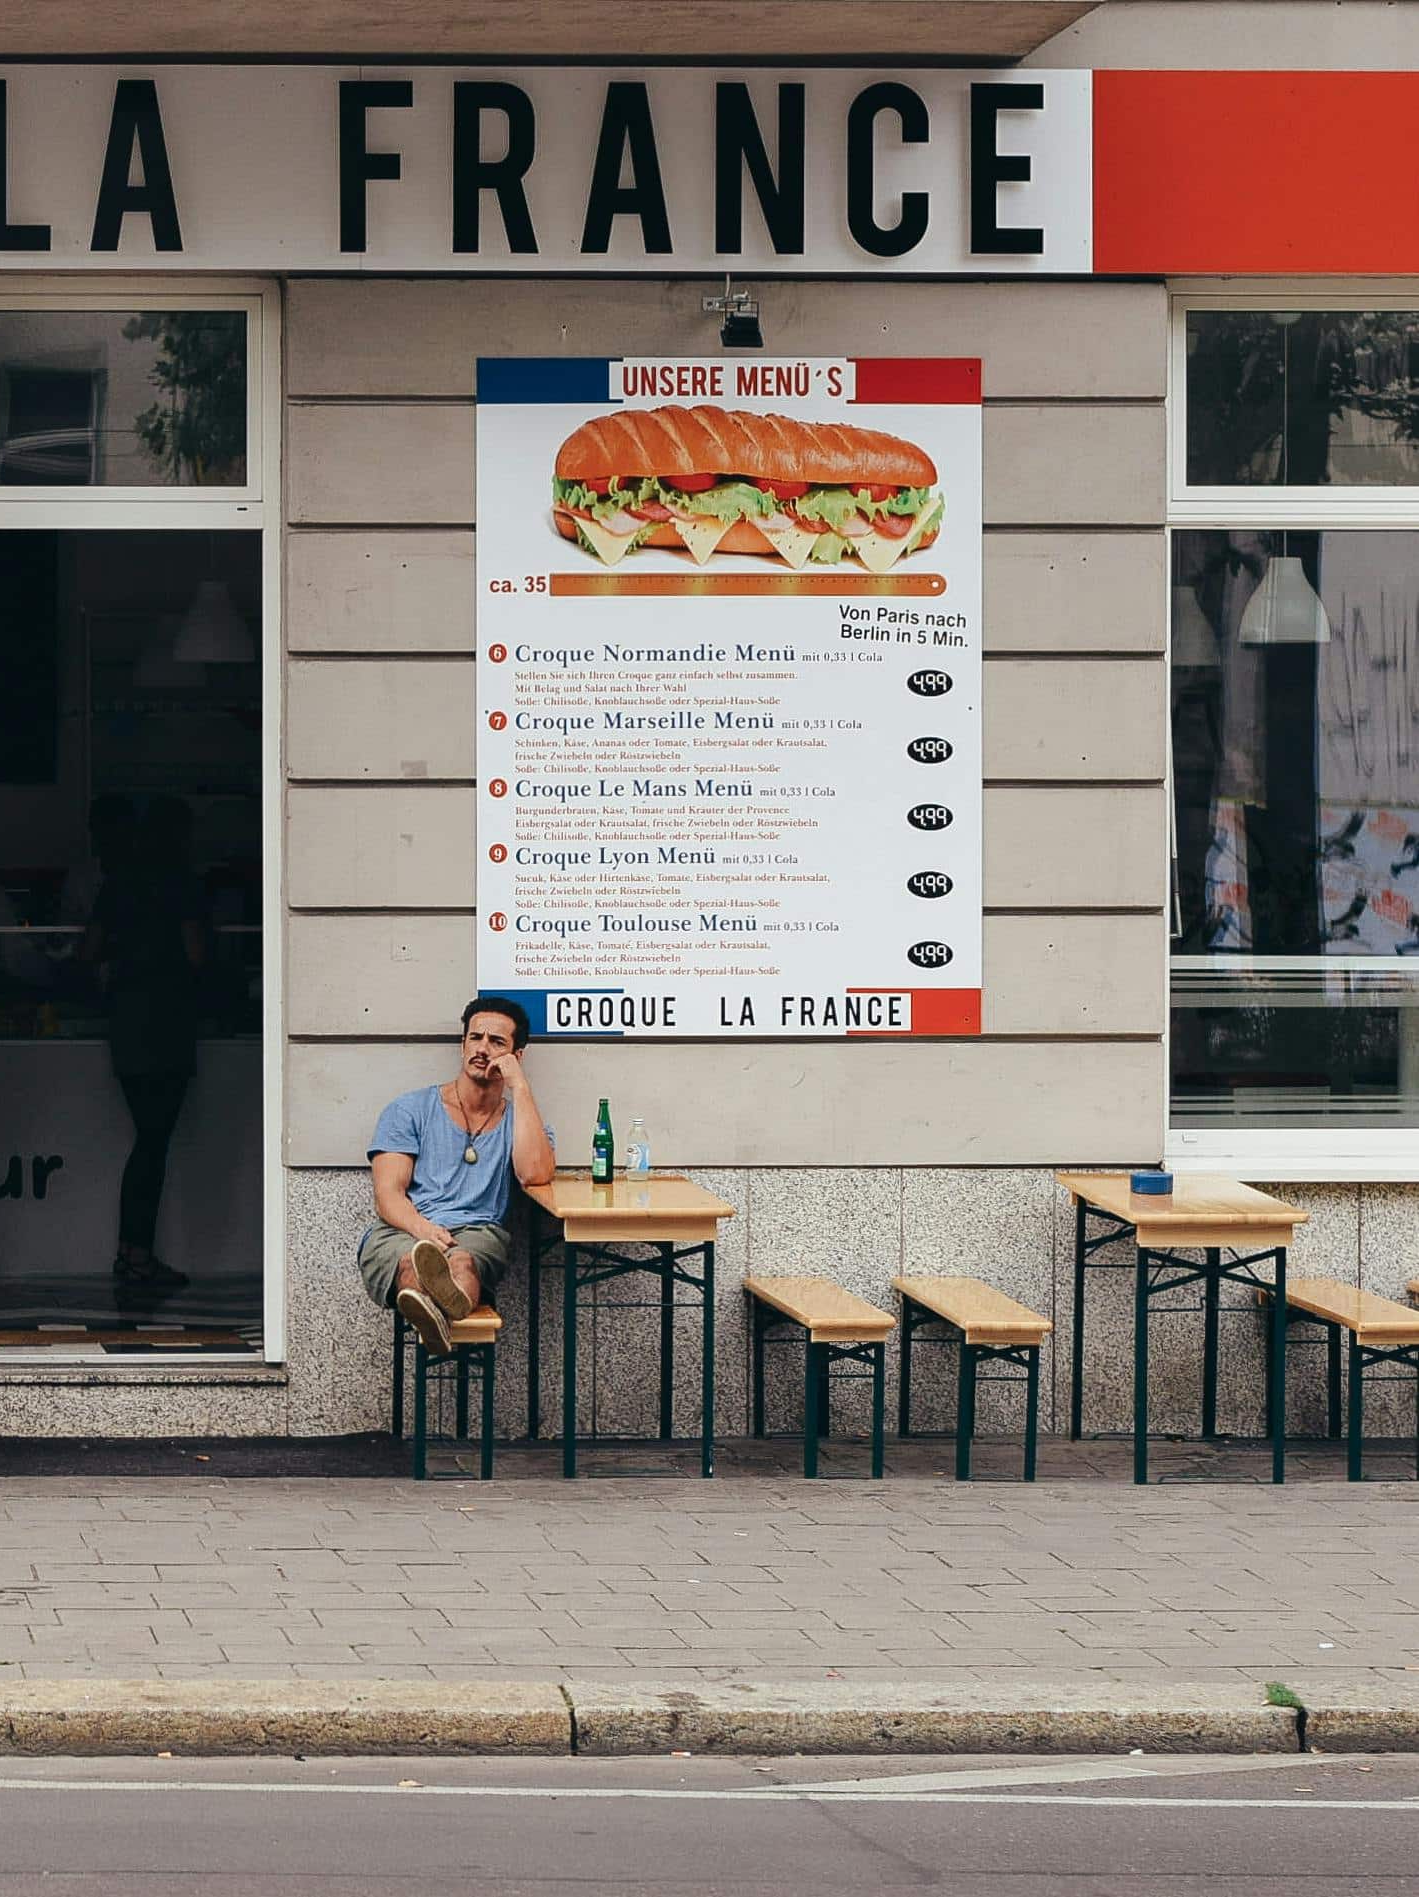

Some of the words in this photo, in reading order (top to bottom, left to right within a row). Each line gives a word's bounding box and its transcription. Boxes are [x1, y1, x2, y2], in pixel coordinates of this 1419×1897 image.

[338, 80, 1045, 258] FRANCE
[622, 366, 723, 397] UNSERE
[490, 581, 517, 593] ca.
[525, 576, 546, 592] 35
[839, 604, 871, 621] Von
[876, 607, 920, 625] Paris
[925, 613, 967, 629] nach
[841, 624, 890, 641] Berlin
[896, 628, 911, 643] in
[917, 630, 927, 644] 5
[933, 630, 968, 648] Min.
[516, 645, 594, 668] Croque
[603, 644, 726, 661] Normandie
[735, 644, 795, 661] Menü
[800, 652, 819, 661] mit
[824, 652, 846, 662] 0,33
[858, 652, 882, 664] Cola
[515, 684, 531, 693] Mit
[534, 684, 561, 695] Belag
[563, 684, 582, 693] und
[584, 684, 607, 693] Salat
[610, 684, 632, 693] nach
[636, 684, 660, 693] Ihrer
[663, 684, 686, 693] Wahl
[516, 712, 594, 736] Croque
[604, 711, 706, 729] Marseille
[714, 712, 774, 729] Menü
[782, 720, 799, 728] mit
[804, 720, 826, 730] 0,33
[838, 720, 861, 729] Cola
[516, 780, 591, 803] Croque
[599, 780, 624, 796] Le
[632, 780, 686, 796] Mans
[694, 779, 752, 796] Menü
[760, 787, 776, 796] mit
[780, 787, 801, 797] 0,33
[812, 787, 835, 796] Cola
[516, 847, 591, 871] Croque
[599, 847, 650, 870] Lyon
[657, 847, 715, 864] Menü
[723, 855, 739, 864] mit
[743, 855, 764, 864] 0,33
[775, 854, 797, 864] Cola
[516, 915, 591, 938] Croque
[598, 914, 693, 932] Toulouse
[698, 914, 757, 931] Menü
[764, 922, 780, 931] mit
[784, 922, 805, 932] 0,33
[816, 922, 839, 931] Cola
[555, 996, 676, 1029] CROQUE
[720, 997, 755, 1027] LA
[781, 997, 903, 1027] FRANCE
